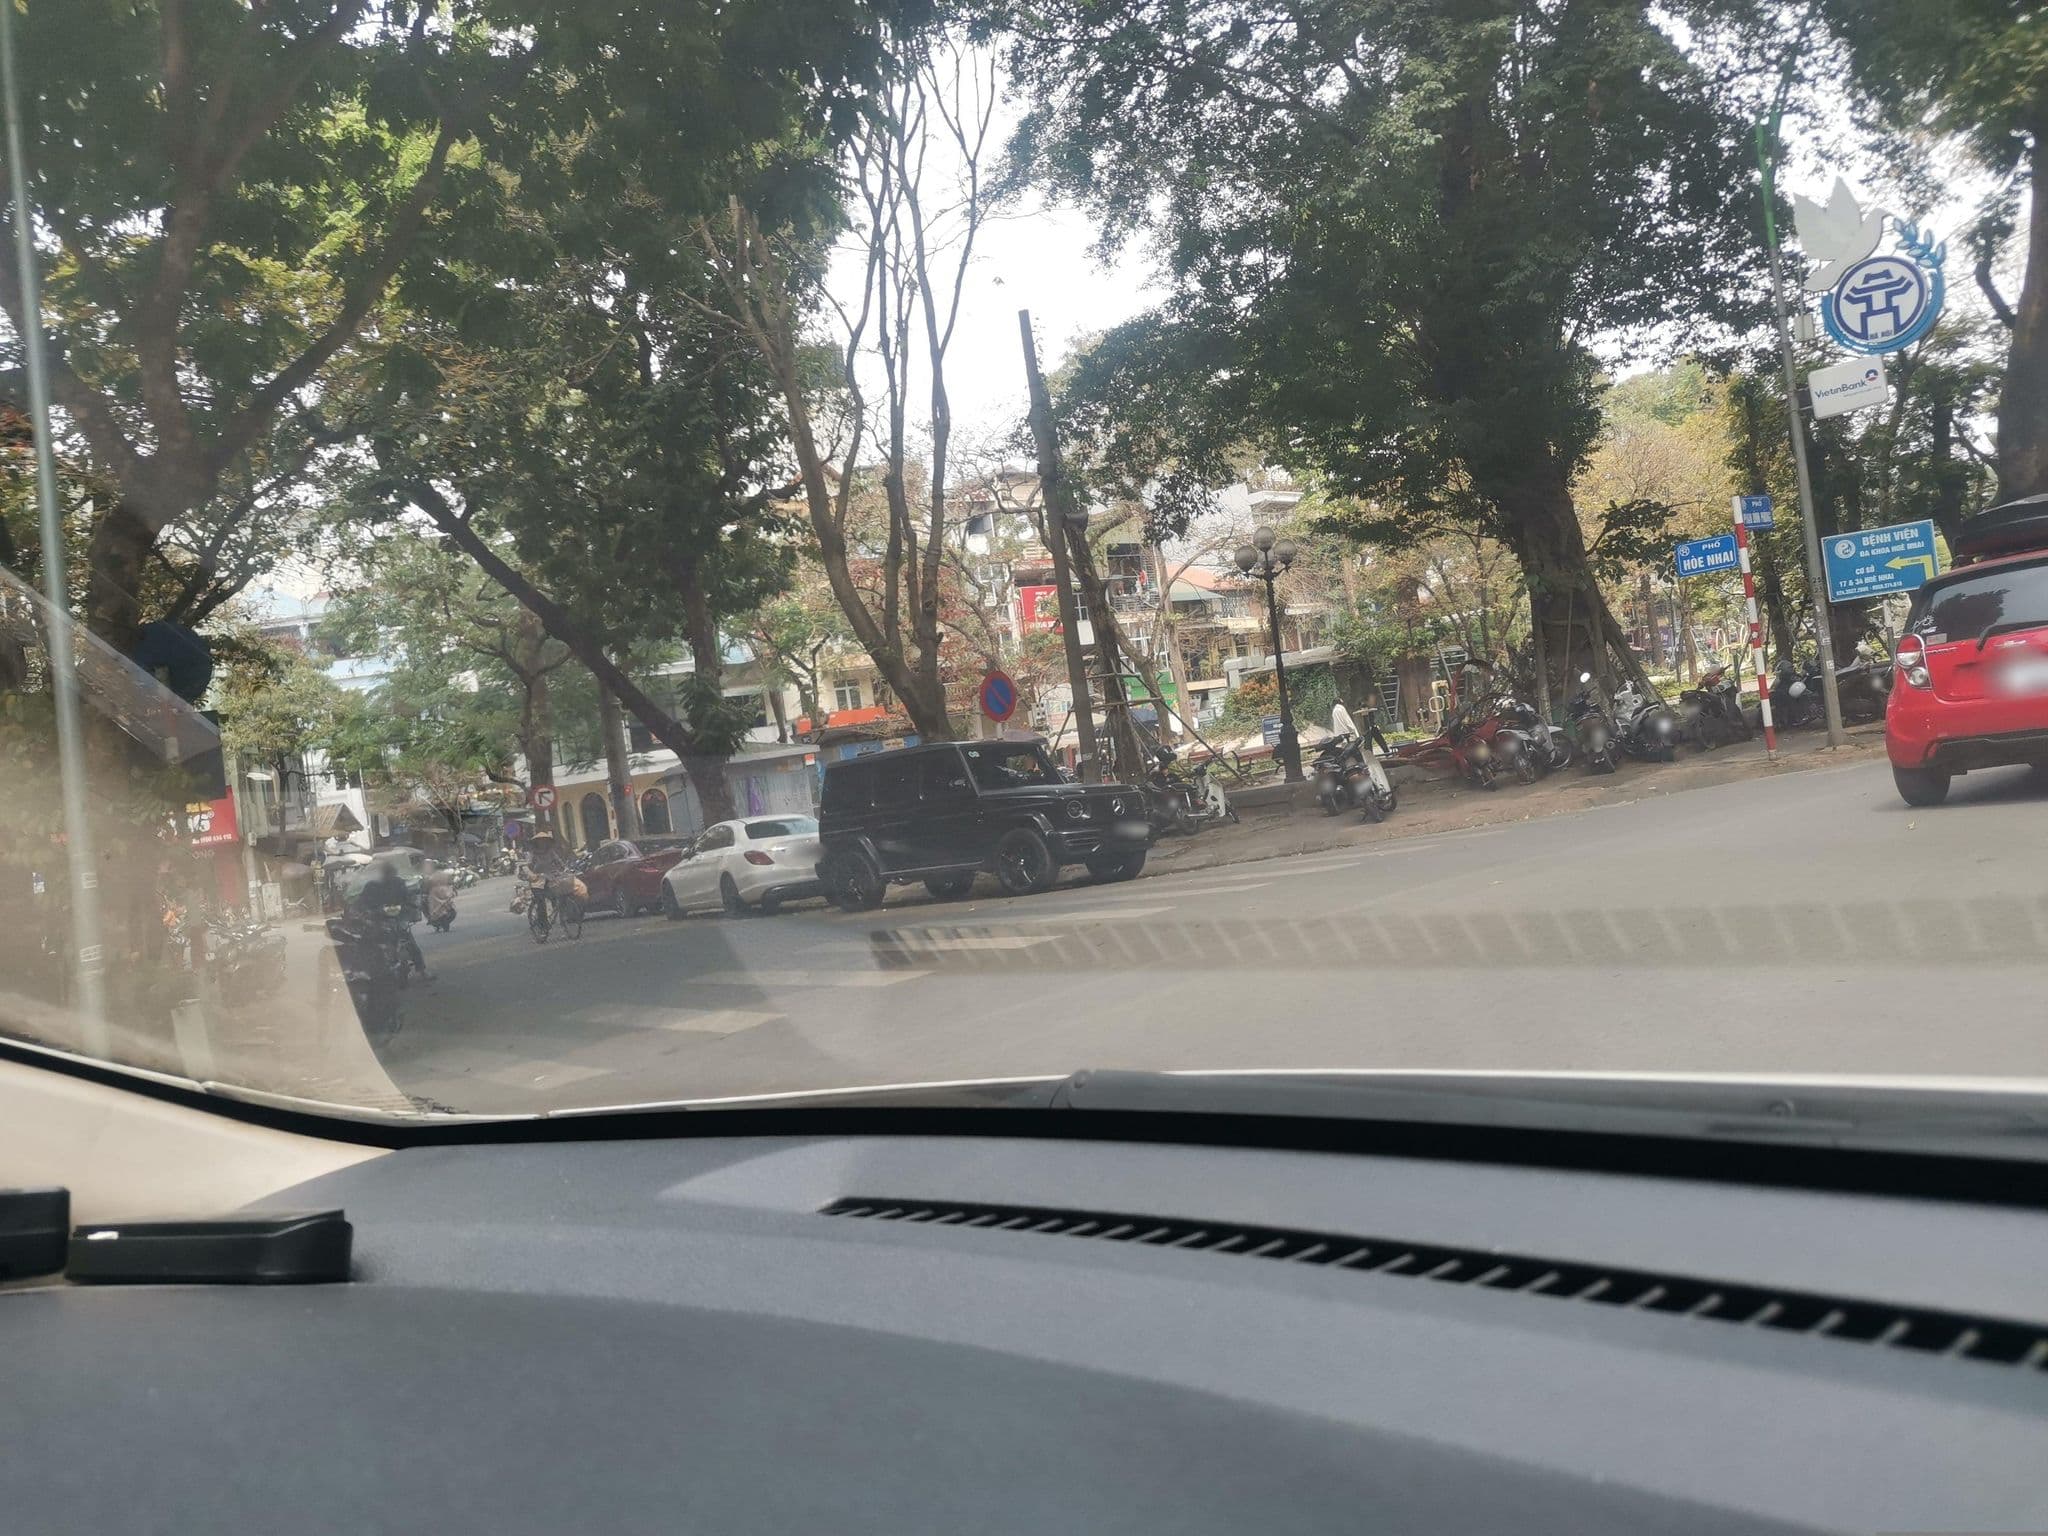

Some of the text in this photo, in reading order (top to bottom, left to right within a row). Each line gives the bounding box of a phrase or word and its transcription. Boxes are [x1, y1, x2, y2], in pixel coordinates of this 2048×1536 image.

[1814, 379, 1867, 398] VietinBank
[1701, 540, 1721, 551] PHỐ
[1862, 527, 1919, 546] BỆNH VIỆN
[1683, 550, 1733, 571] HÒE NHAI
